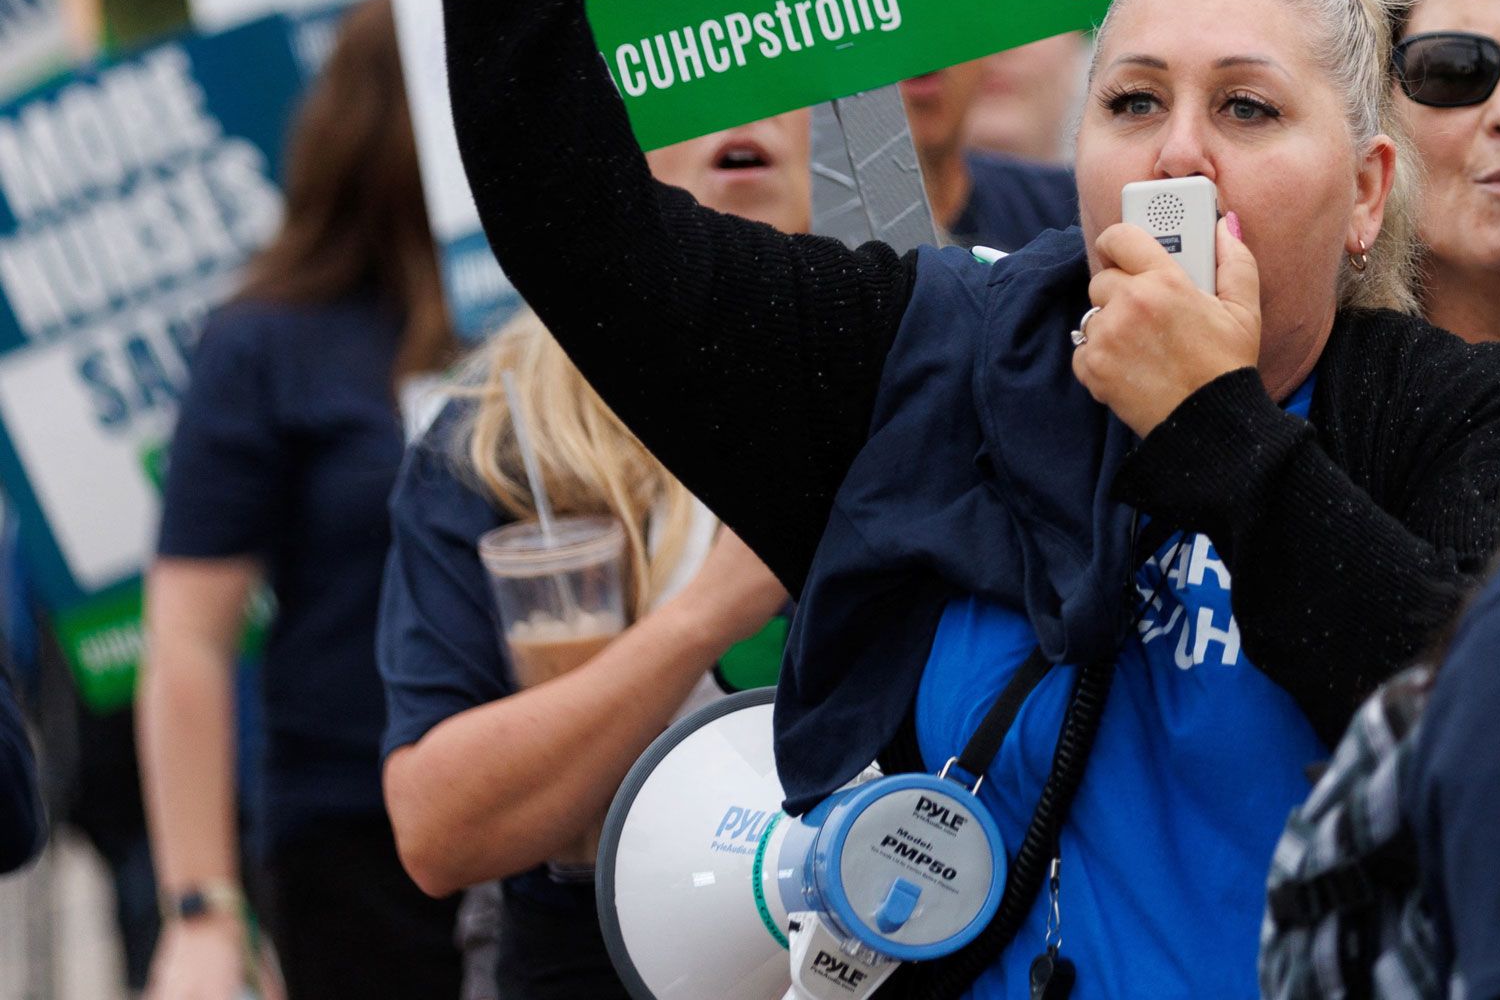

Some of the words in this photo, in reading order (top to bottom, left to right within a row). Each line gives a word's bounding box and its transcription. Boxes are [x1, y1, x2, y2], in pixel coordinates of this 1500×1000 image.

[0, 43, 223, 220] MORE
[915, 796, 966, 832] PYLE
[880, 834, 957, 881] PMP50
[813, 950, 866, 988] PYLE
